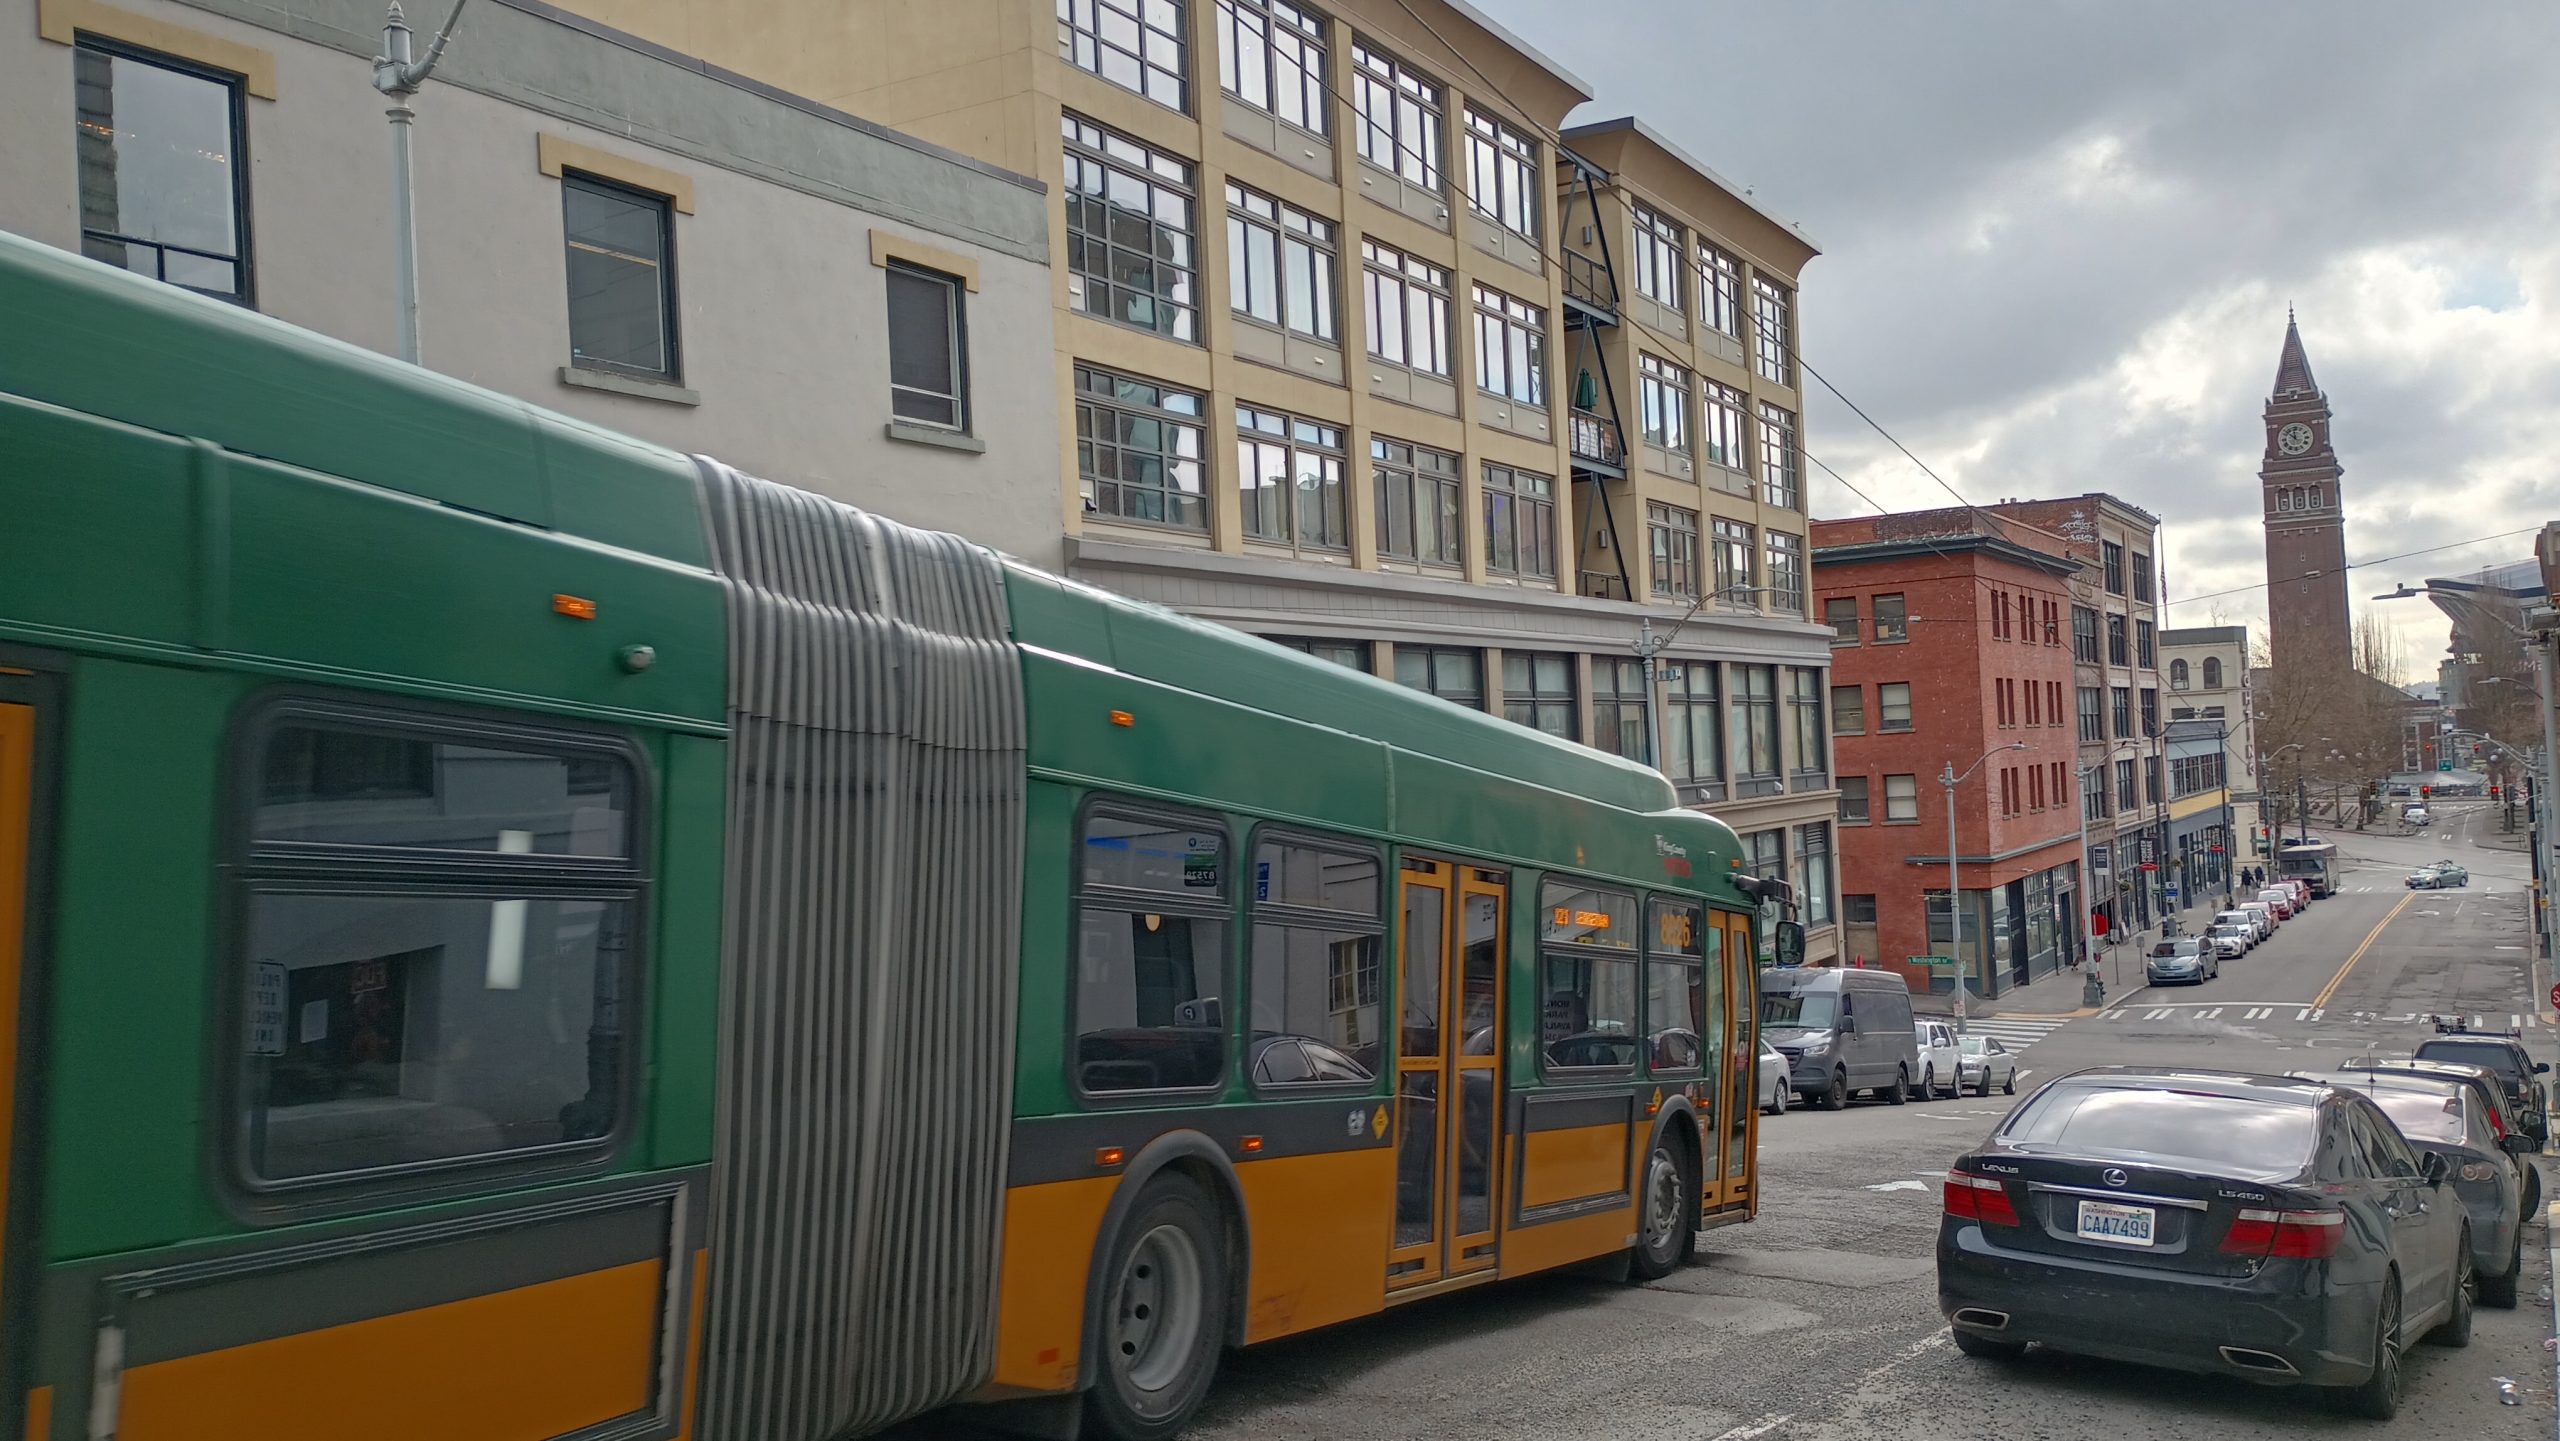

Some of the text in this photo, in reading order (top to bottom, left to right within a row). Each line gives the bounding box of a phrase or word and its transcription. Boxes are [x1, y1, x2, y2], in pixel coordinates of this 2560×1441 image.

[1981, 1163, 2019, 1174] LEXUS
[2085, 1207, 2126, 1217] WASHINGTON
[2083, 1214, 2149, 1239] CAA7499
